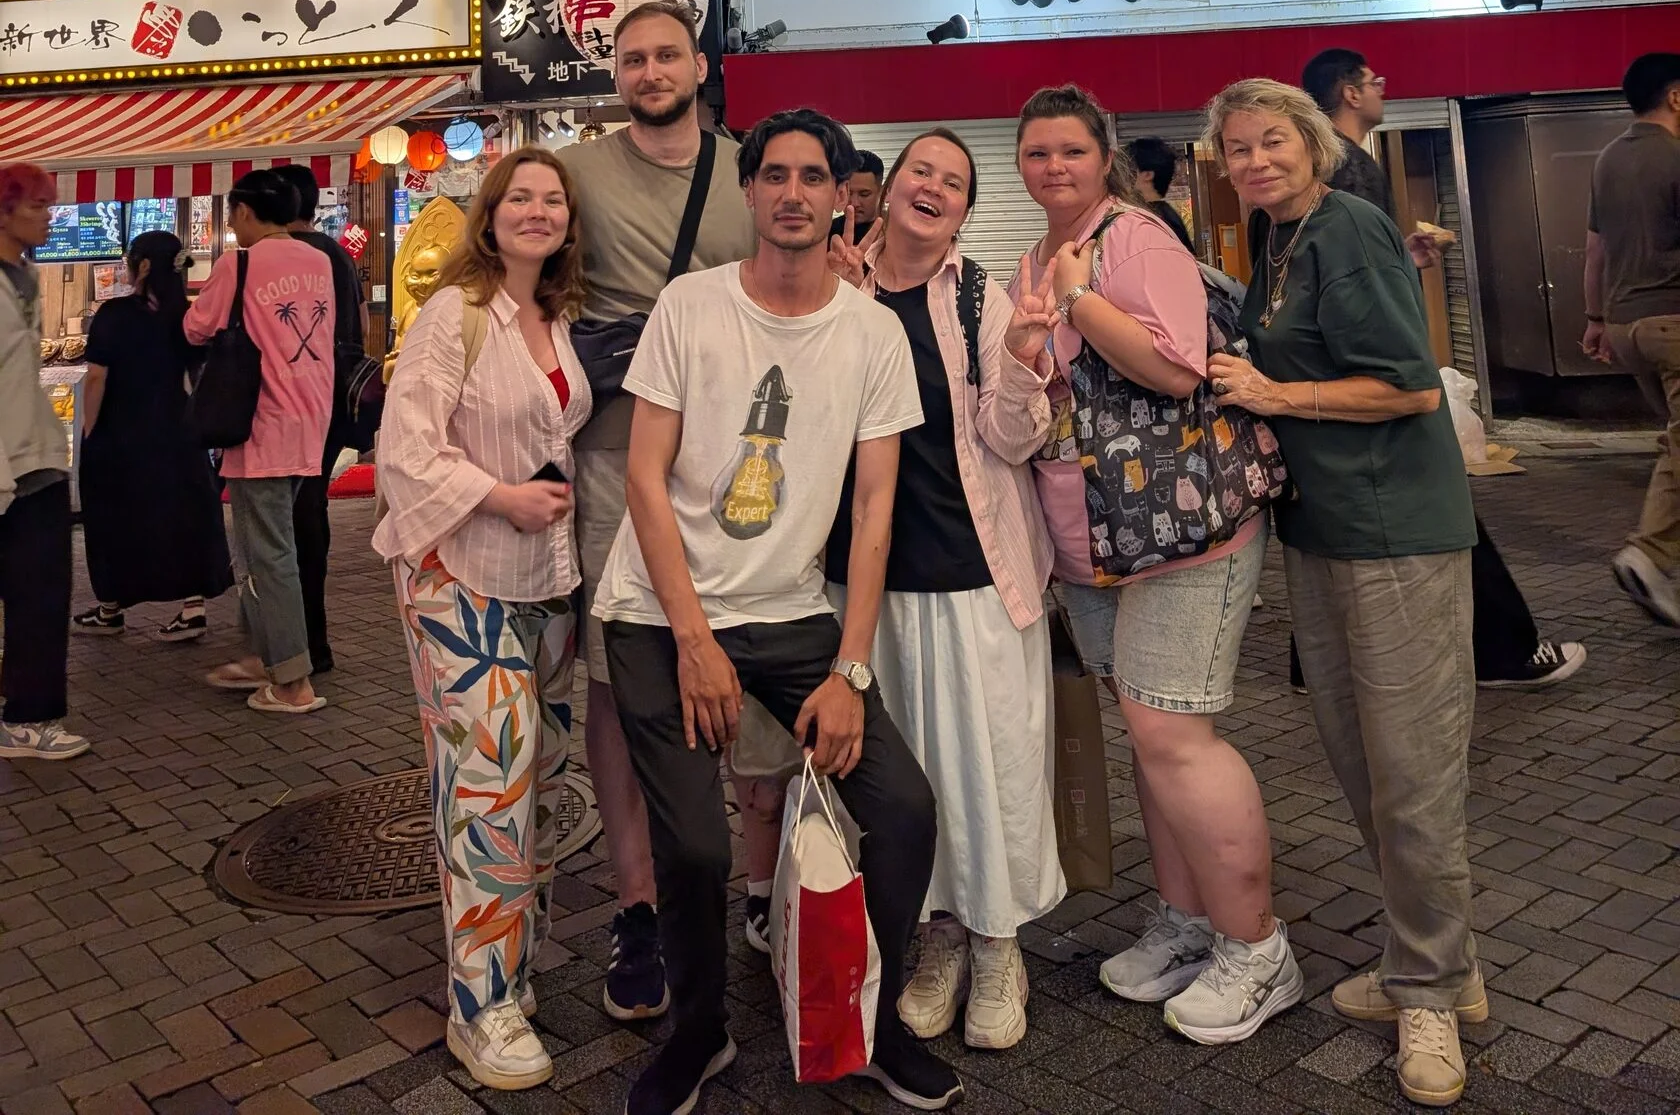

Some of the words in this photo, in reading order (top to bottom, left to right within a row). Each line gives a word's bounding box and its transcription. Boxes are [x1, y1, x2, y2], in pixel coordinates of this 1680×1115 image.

[0, 19, 126, 54] 新世界
[255, 275, 300, 306] GOOD
[727, 501, 769, 525] Expert
